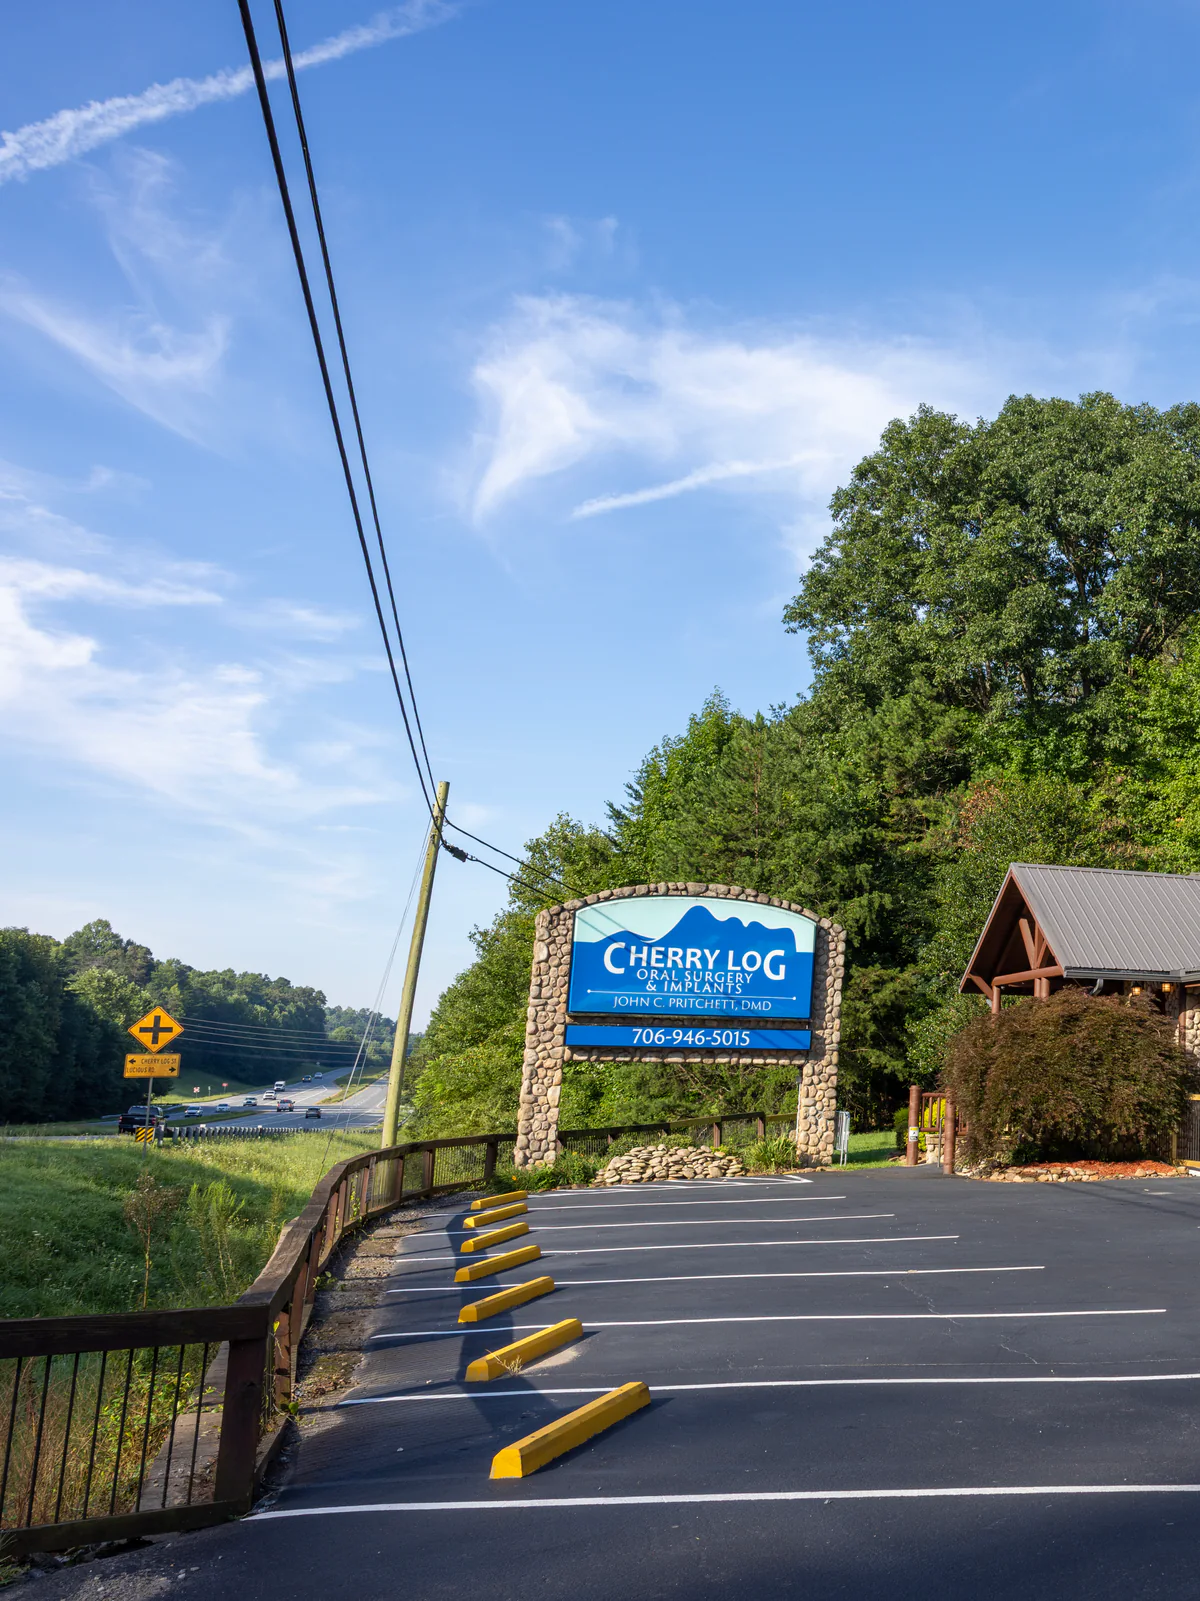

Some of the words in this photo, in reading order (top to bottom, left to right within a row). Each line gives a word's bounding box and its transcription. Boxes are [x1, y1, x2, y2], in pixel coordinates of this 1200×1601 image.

[603, 941, 721, 974] CHERRY
[727, 949, 786, 981] LOG
[636, 968, 679, 981] ORAL
[684, 970, 753, 984] SURGERY
[645, 980, 657, 992] &
[663, 980, 742, 994] IMPLANTS
[613, 996, 650, 1008] JOHN
[653, 997, 665, 1008] C.
[668, 998, 738, 1011] PRITCHETT,
[741, 1000, 772, 1011] DMD
[632, 1028, 750, 1046] 706-946-5015
